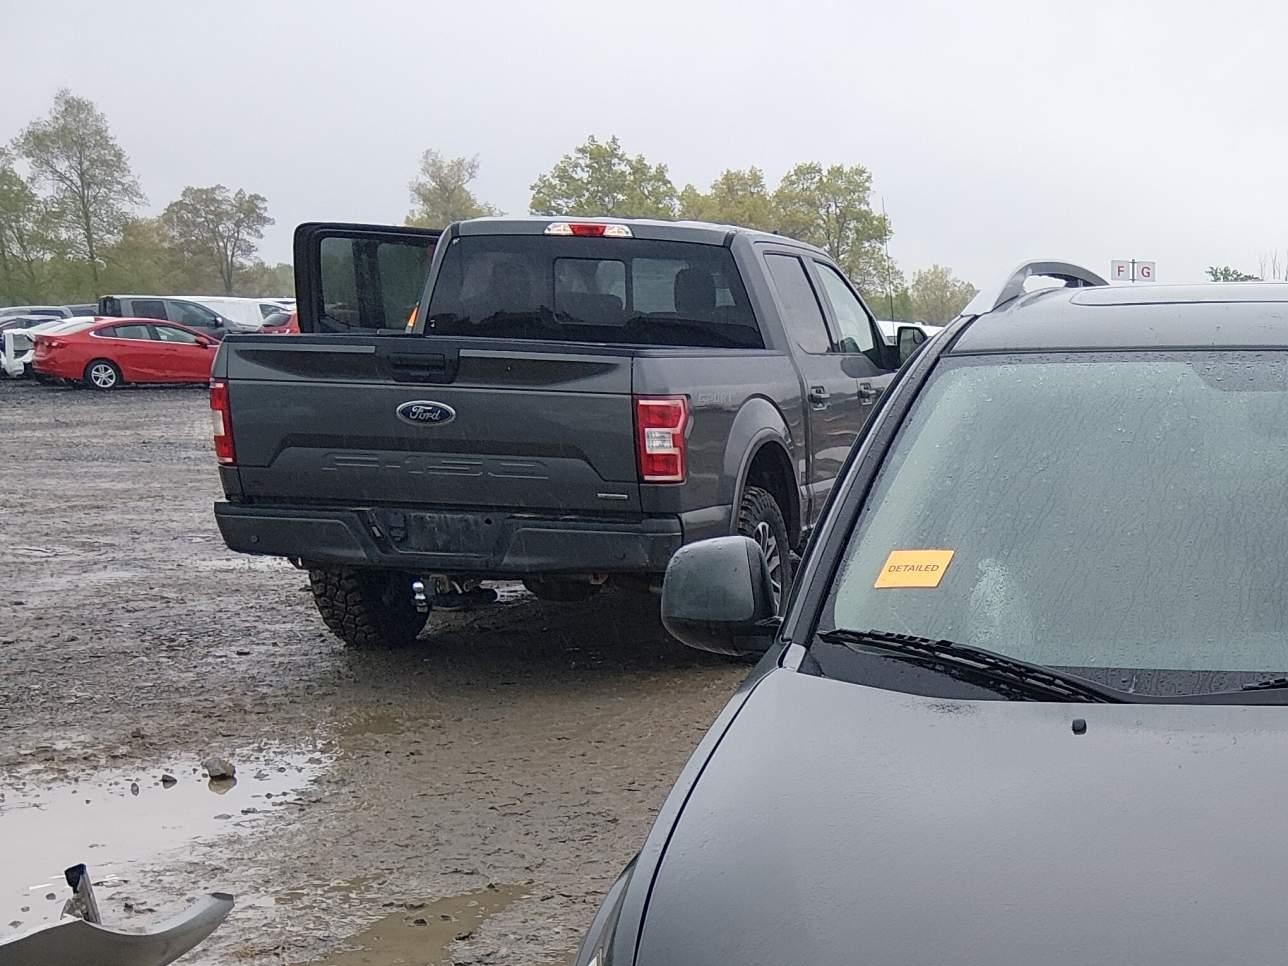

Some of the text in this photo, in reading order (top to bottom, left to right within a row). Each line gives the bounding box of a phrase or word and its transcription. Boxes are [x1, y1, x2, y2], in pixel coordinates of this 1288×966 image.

[1117, 265, 1125, 277] F
[1141, 266, 1151, 278] G
[410, 405, 441, 420] Ford
[887, 564, 940, 573] DETAILED
